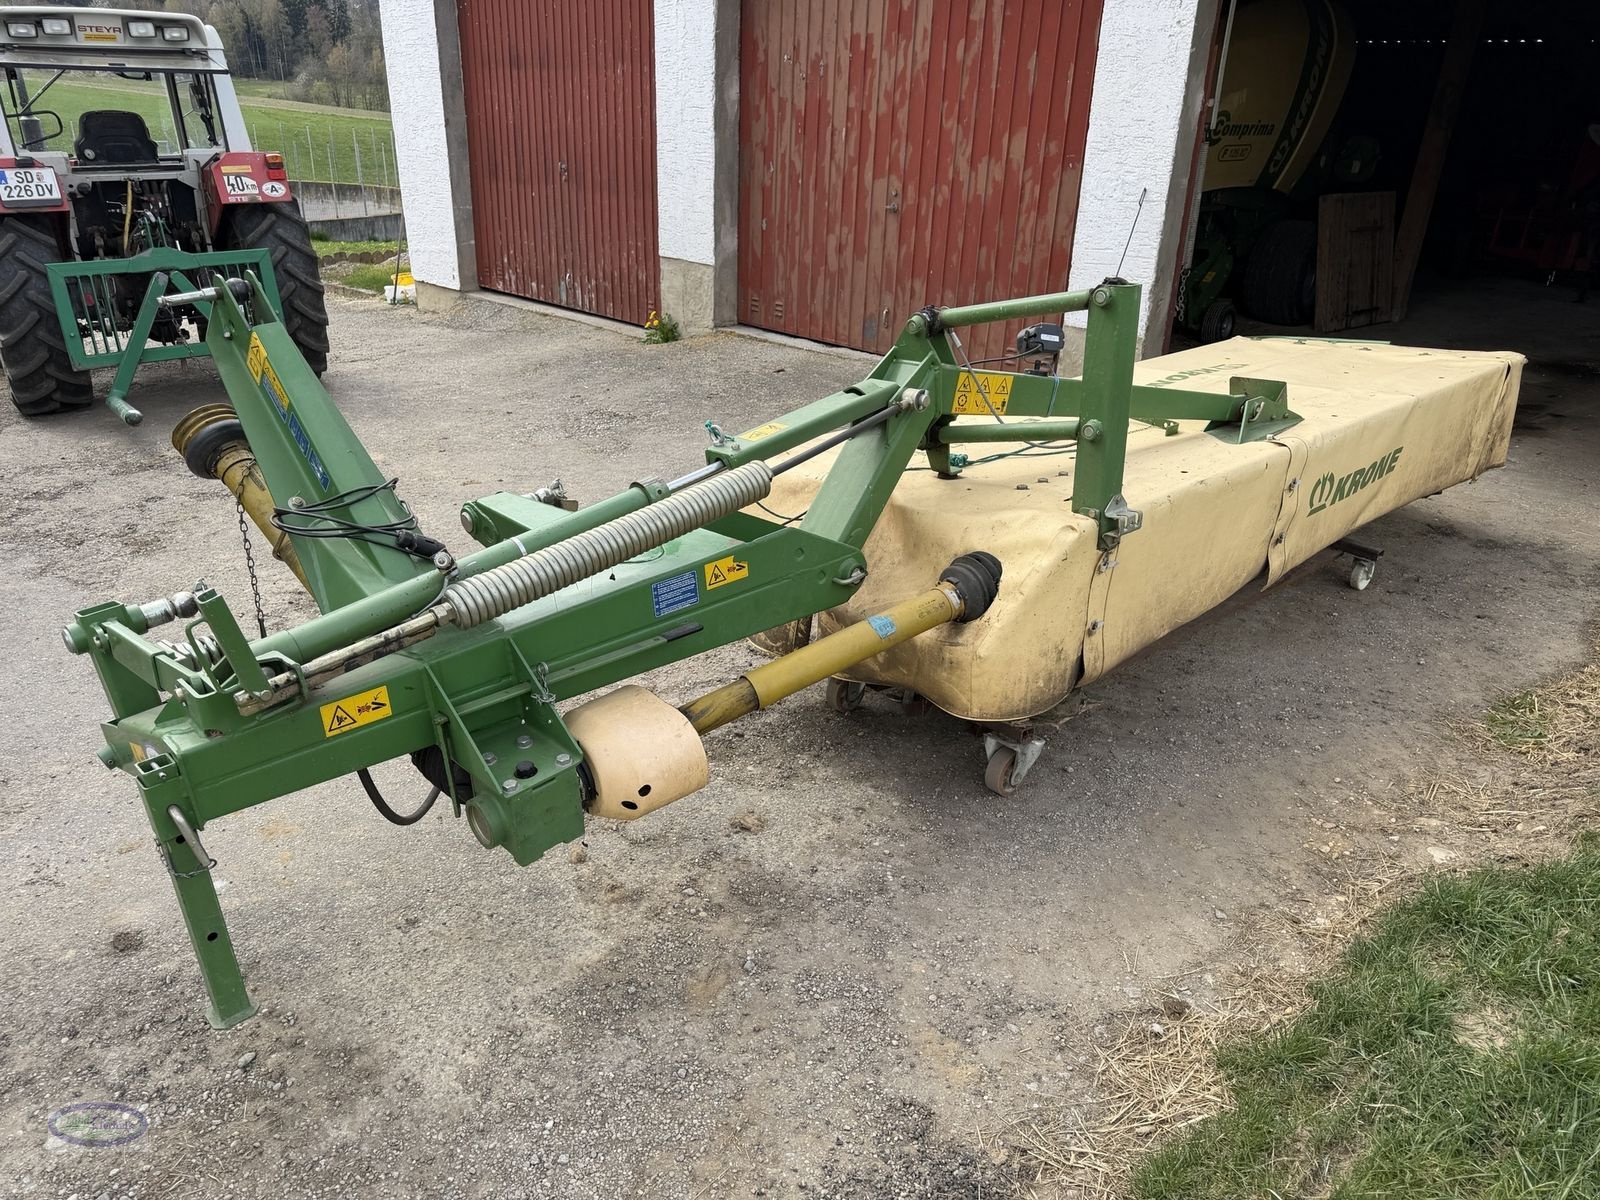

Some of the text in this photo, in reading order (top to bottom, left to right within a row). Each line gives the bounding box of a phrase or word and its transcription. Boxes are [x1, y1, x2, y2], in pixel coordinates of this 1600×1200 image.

[77, 24, 122, 34] STEYR
[1213, 119, 1275, 140] Comprima
[14, 170, 34, 184] SD
[227, 175, 245, 192] 40
[4, 184, 53, 198] 226 DV
[270, 184, 279, 194] A
[1329, 446, 1404, 507] KRONE
